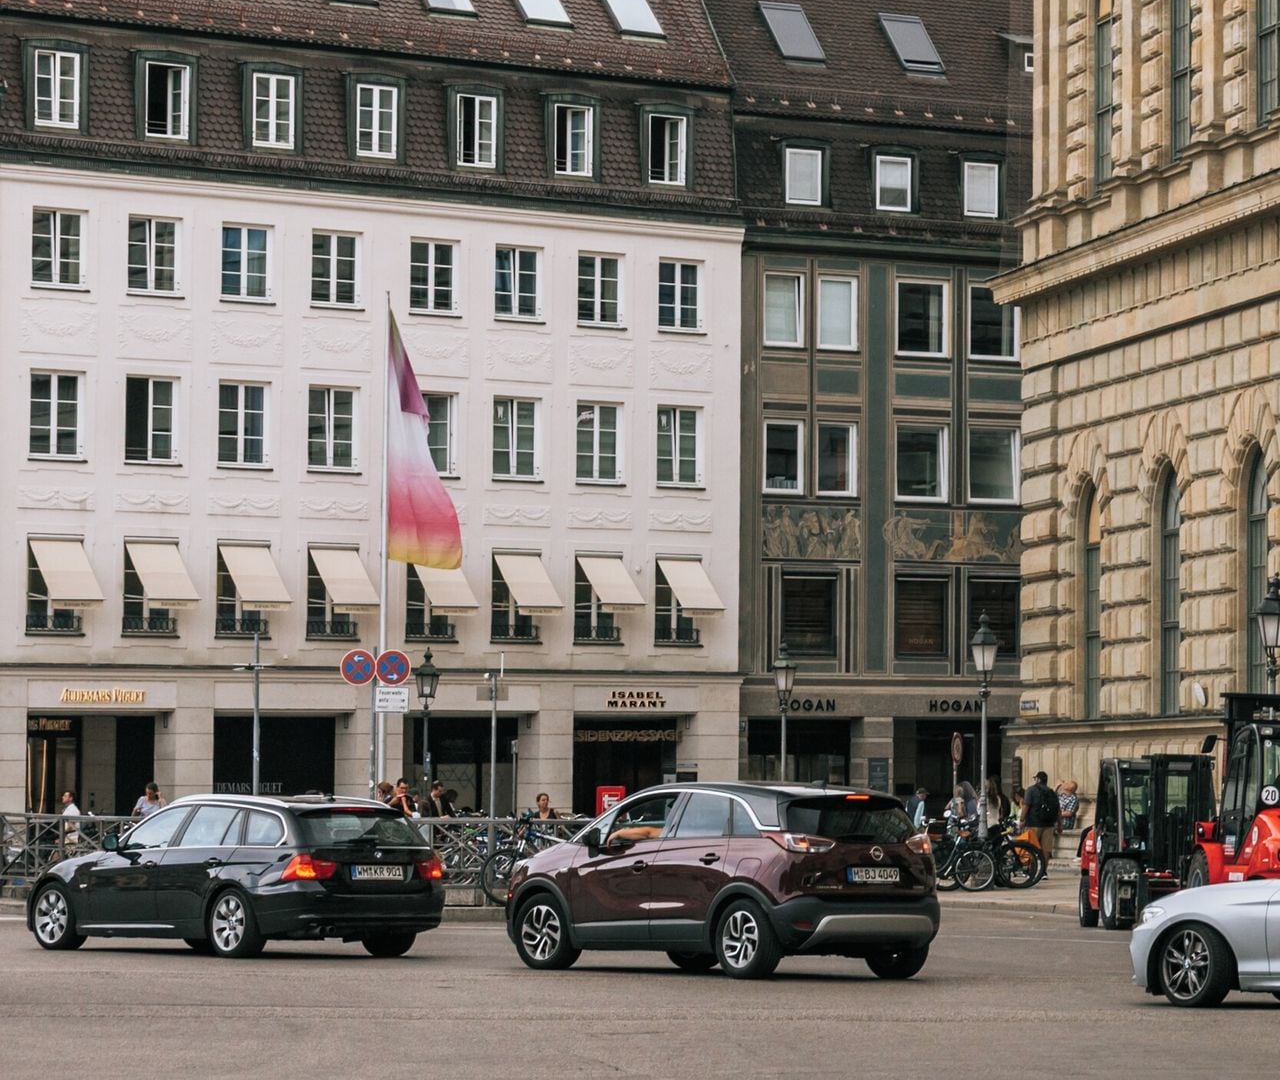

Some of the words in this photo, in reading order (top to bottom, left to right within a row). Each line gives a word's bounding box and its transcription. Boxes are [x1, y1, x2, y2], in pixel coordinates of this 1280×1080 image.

[611, 691, 663, 699] ISABEL
[607, 700, 667, 708] MARANT
[929, 699, 983, 712] HOGAN
[216, 782, 252, 793] DEMARS
[259, 782, 283, 793] IGUET
[1265, 789, 1276, 801] 20
[864, 869, 876, 880] BJ
